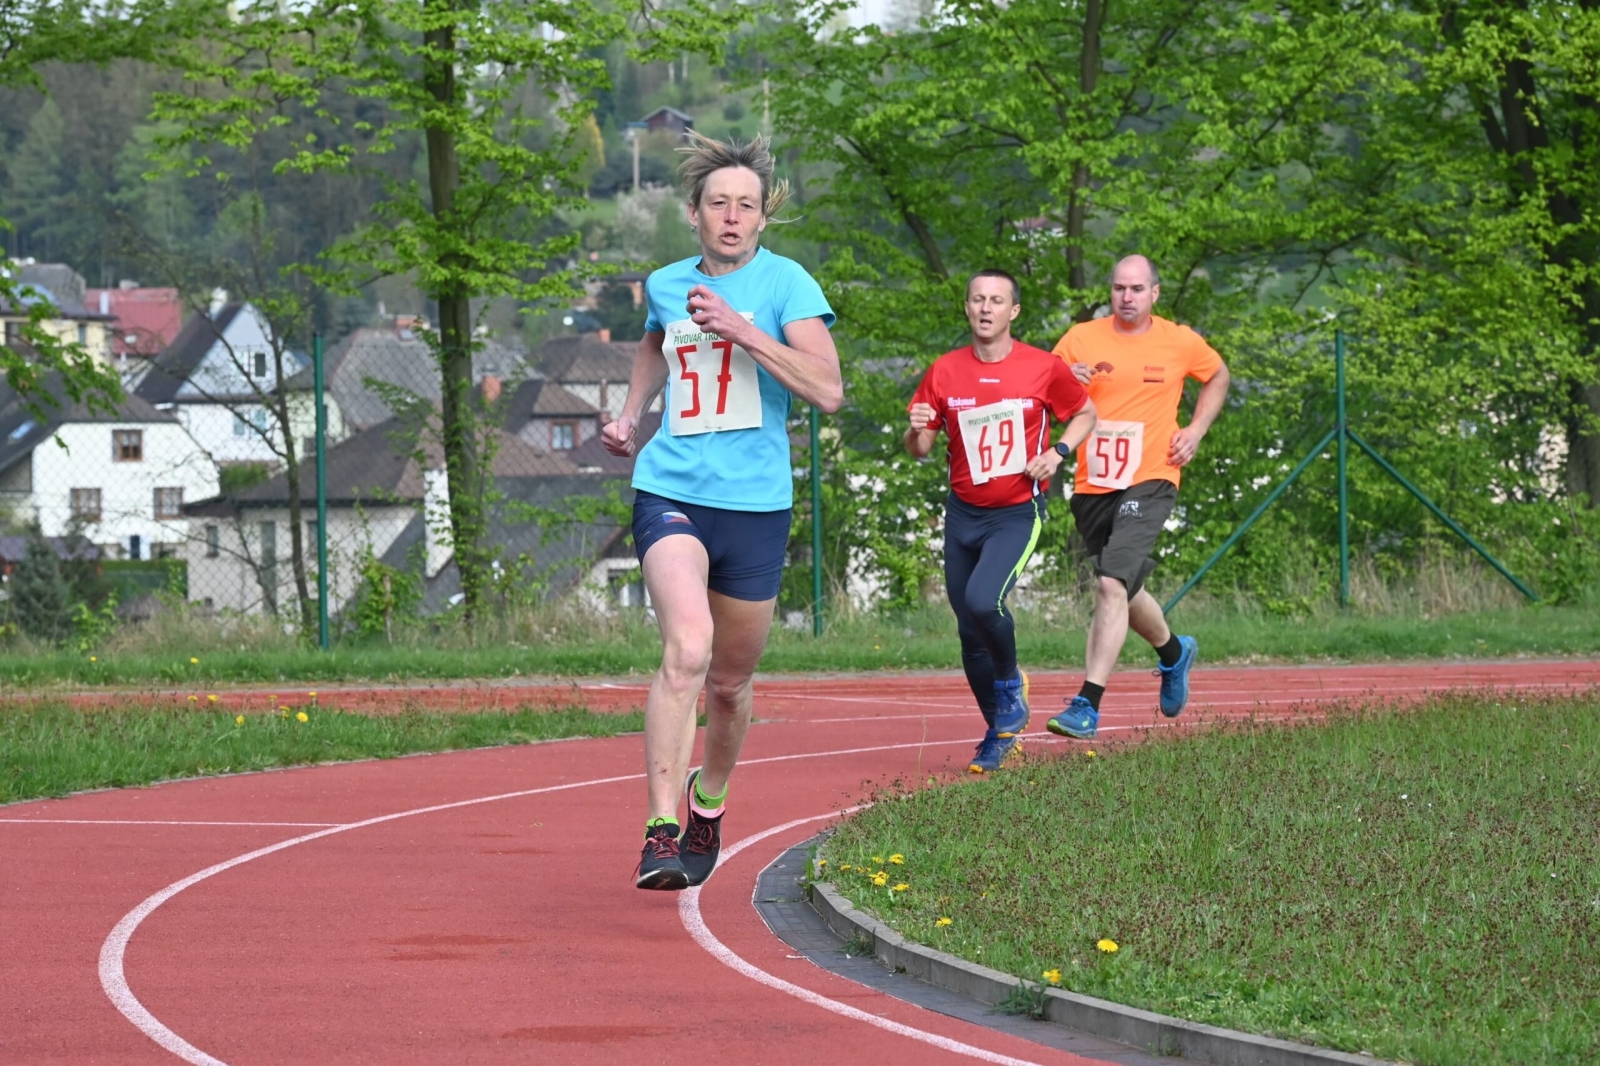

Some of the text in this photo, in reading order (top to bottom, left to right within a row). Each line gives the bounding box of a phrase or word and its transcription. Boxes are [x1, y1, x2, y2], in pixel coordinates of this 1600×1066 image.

[673, 333, 702, 345] PIVOVAR
[676, 341, 733, 418] 57
[967, 410, 1015, 426] PIVOVAR TRUTNOV
[978, 419, 1014, 473] 69
[1096, 437, 1130, 480] 59
